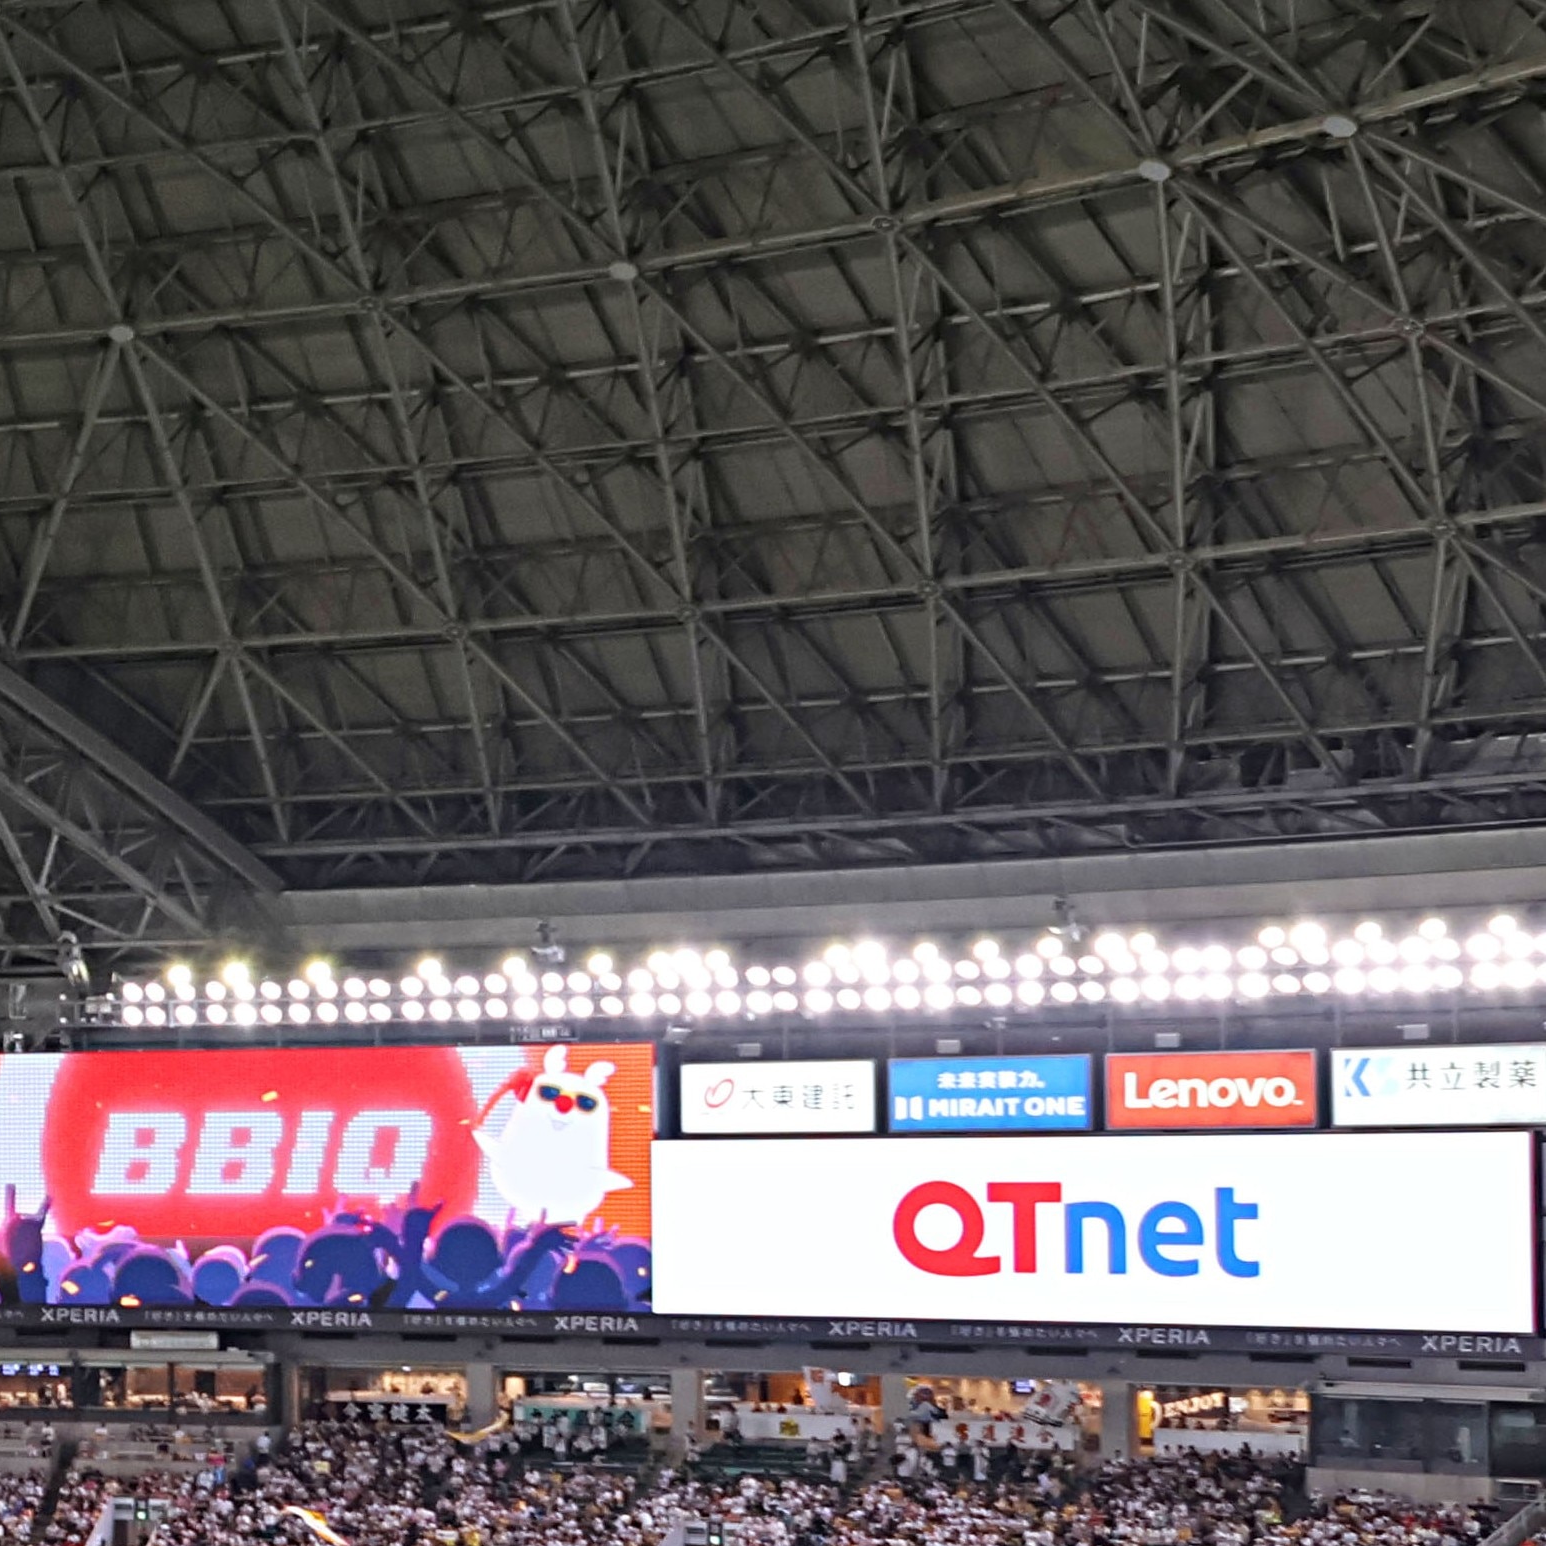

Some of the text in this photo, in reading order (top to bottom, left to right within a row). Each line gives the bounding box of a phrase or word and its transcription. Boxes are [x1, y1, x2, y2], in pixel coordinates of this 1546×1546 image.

[1406, 1060, 1537, 1091] 共立製薬
[1124, 1072, 1297, 1109] Lenovo
[928, 1096, 1086, 1118] MIRAIT ONE
[90, 1109, 434, 1198] BBIQ
[892, 1180, 1260, 1279] QTnet
[40, 1307, 121, 1324] XPERIA
[290, 1310, 373, 1328] XPERIA
[554, 1315, 639, 1331] XPERIA
[829, 1320, 918, 1338] XPERIA
[1117, 1327, 1211, 1345] XPERIA
[1420, 1335, 1522, 1354] XPERIA
